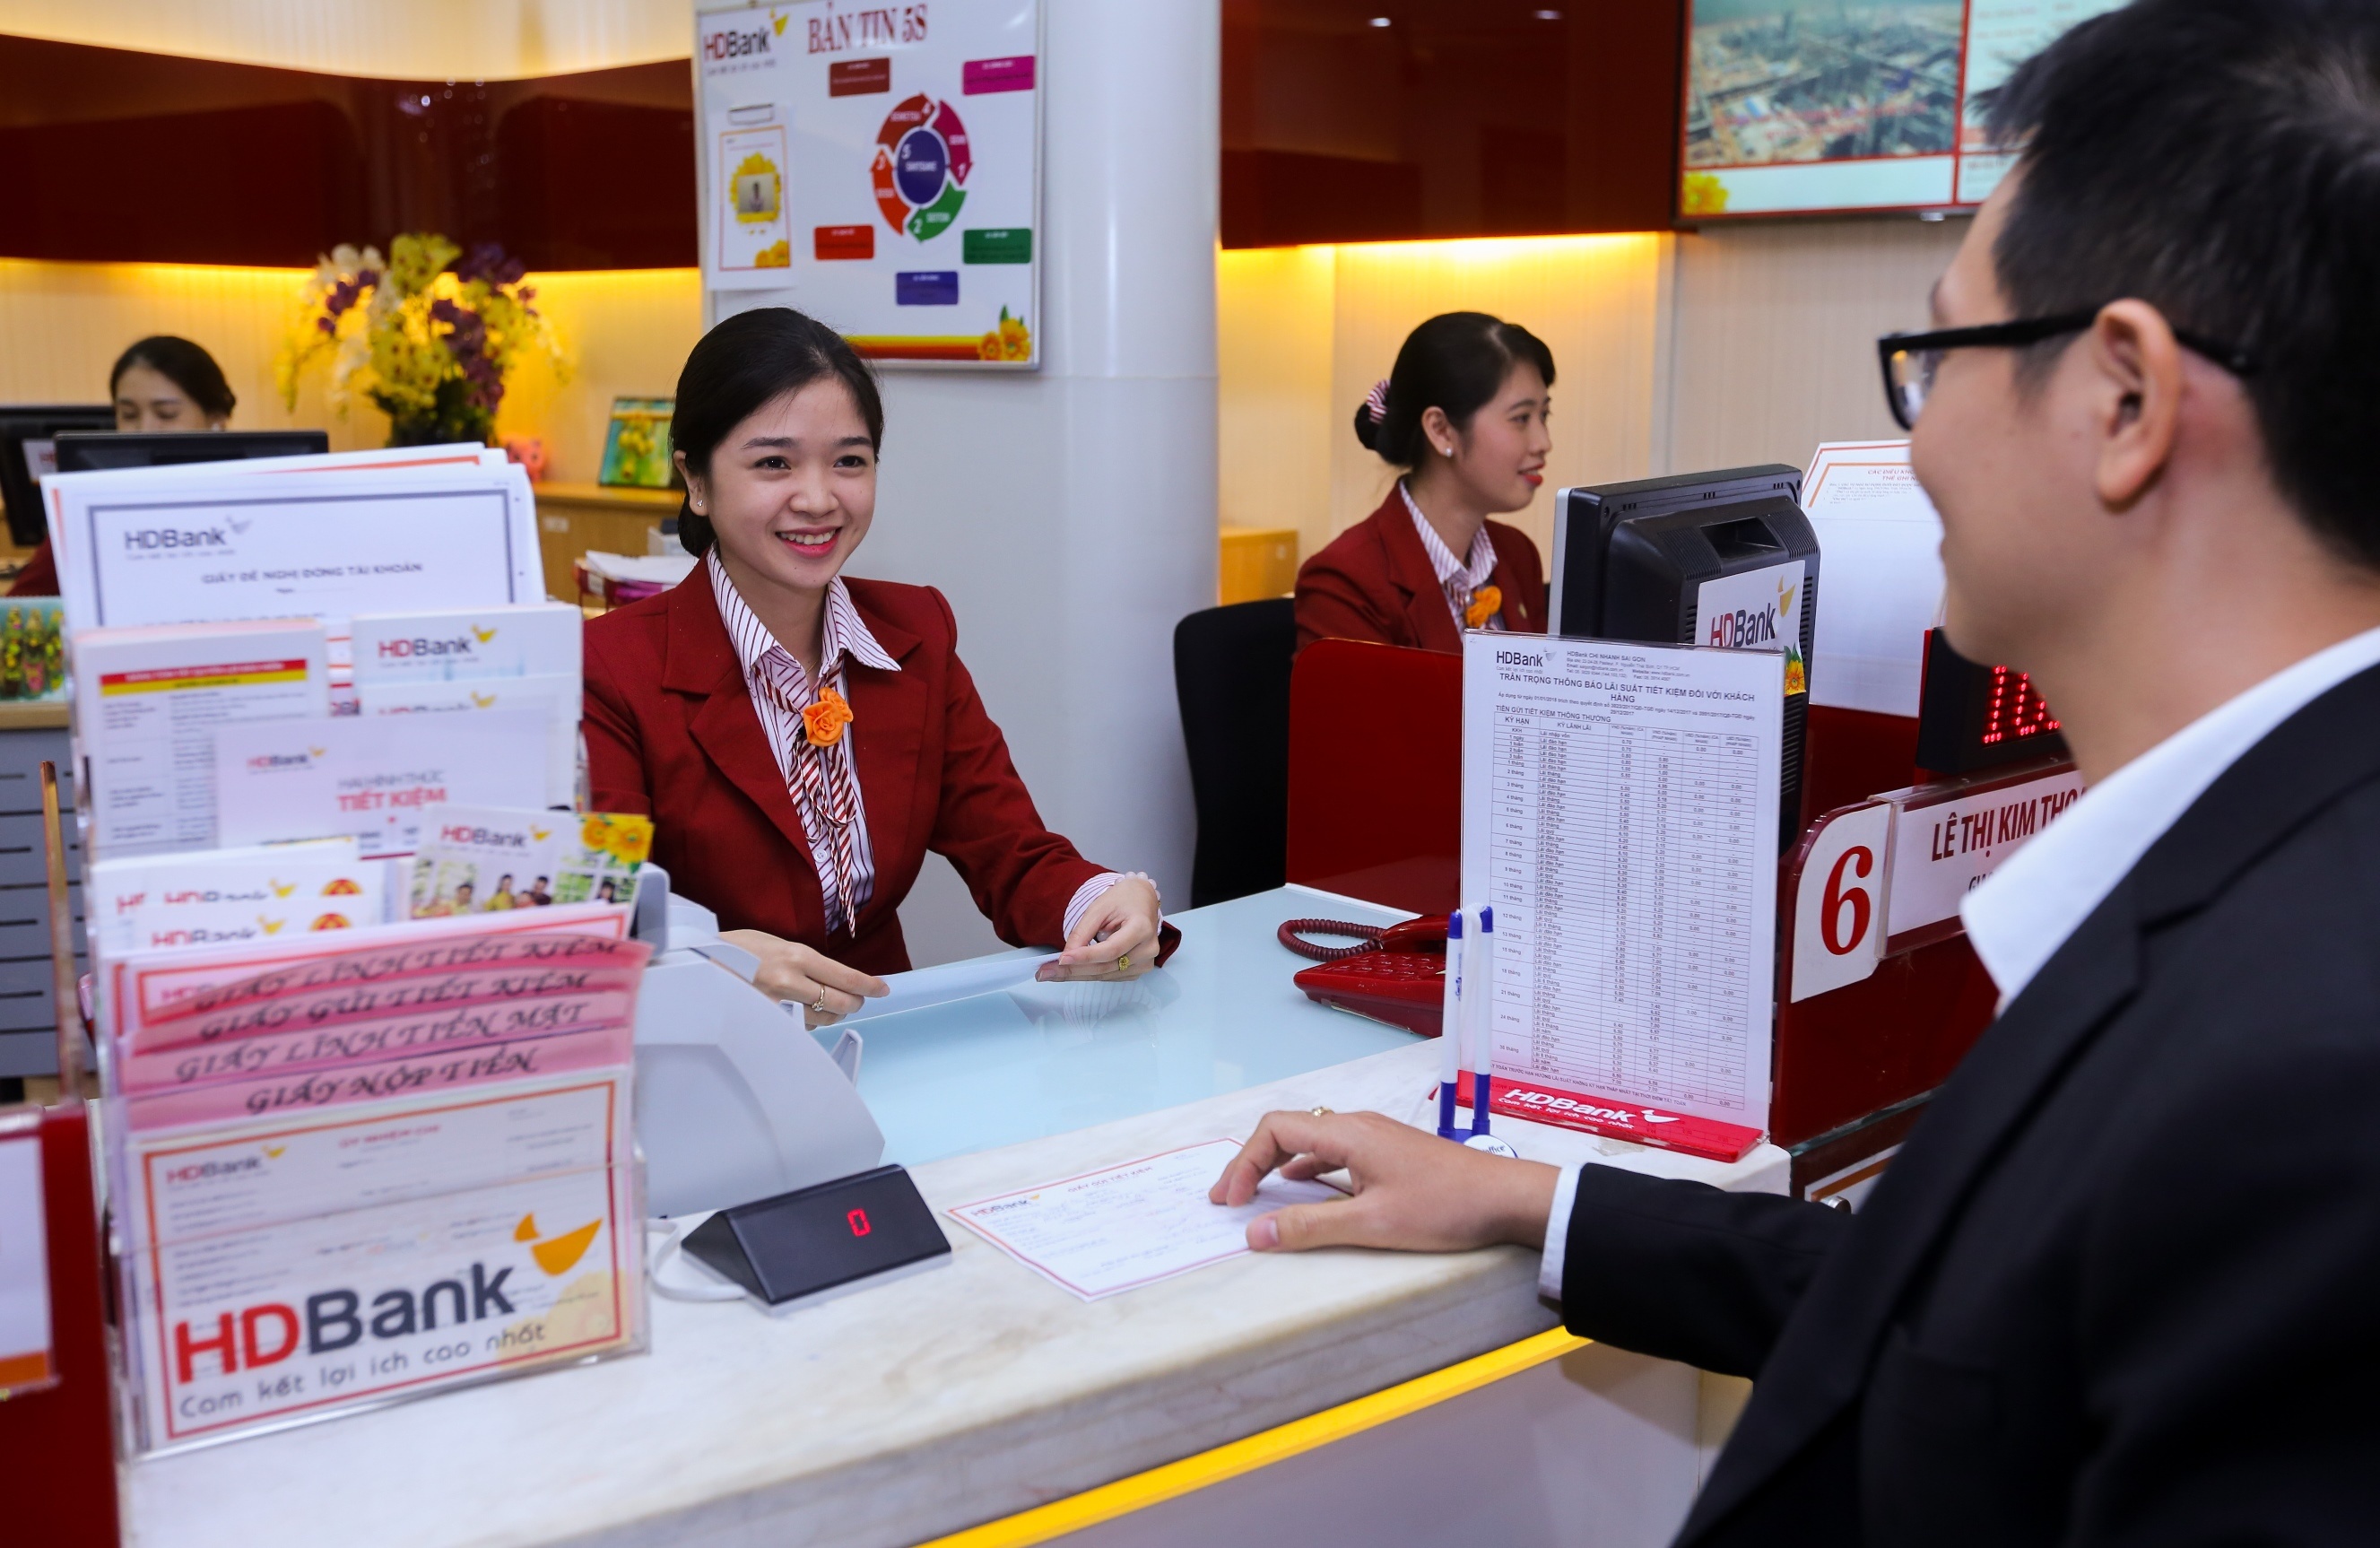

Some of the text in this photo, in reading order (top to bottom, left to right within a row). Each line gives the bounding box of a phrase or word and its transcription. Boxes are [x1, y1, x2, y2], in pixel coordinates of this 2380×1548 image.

[859, 8, 897, 47] TIN
[902, 4, 928, 42] 5S
[704, 27, 770, 61] HDBank
[901, 143, 912, 160] 5
[913, 218, 923, 234] 2
[125, 526, 226, 551] HDBank
[1711, 603, 1776, 647] HDBank
[378, 637, 472, 658] HDBank
[1496, 650, 1543, 667] HDBank
[1524, 674, 1551, 685] TRỌNG
[1585, 679, 1603, 690] BÁO
[1724, 691, 1755, 701] KHÁCH
[1611, 692, 1635, 703] HÀNG
[440, 824, 526, 848] HDBank
[1932, 812, 1957, 861] LÊ
[1961, 810, 1994, 857] THỊ
[1998, 799, 2037, 844] KIM
[1820, 845, 1873, 956] 6
[1504, 1088, 1637, 1123] HDBank
[847, 1207, 872, 1237] 0
[175, 1262, 517, 1385] HDBank
[179, 1322, 546, 1420] Cam kết lợi ích cao nhất
